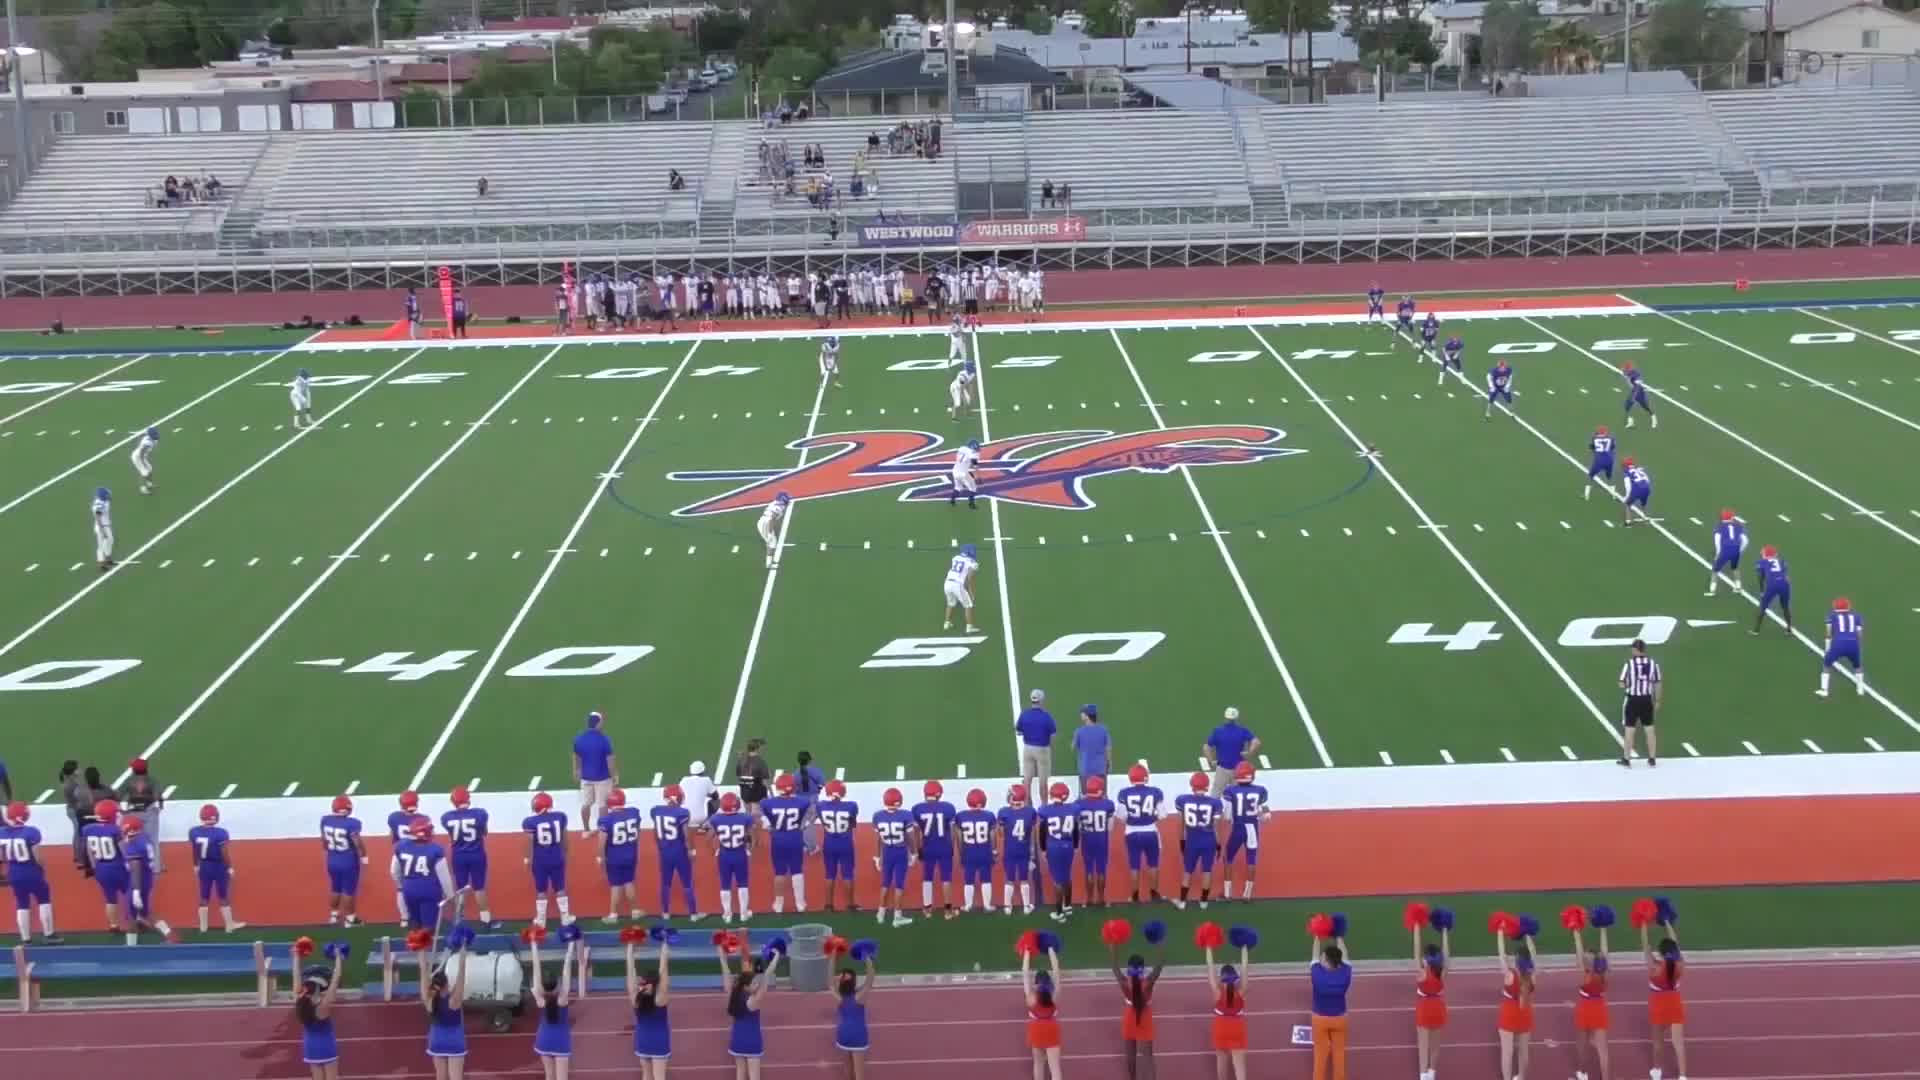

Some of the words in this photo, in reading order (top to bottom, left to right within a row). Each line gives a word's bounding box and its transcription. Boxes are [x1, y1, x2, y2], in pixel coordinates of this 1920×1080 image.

[864, 226, 954, 240] WESTWOOD
[977, 222, 1059, 237] WARRIORS
[1594, 437, 1612, 452] 57
[1727, 525, 1735, 540] 1
[1767, 559, 1781, 572] 3
[1837, 614, 1856, 632] 11
[1127, 795, 1152, 818] 54
[1185, 803, 1211, 826] 63
[1237, 793, 1259, 816] 13
[656, 816, 677, 839] 15
[772, 808, 799, 830] 72
[822, 811, 848, 832] 56
[921, 813, 943, 836] 71
[1012, 820, 1025, 840] 4
[1047, 816, 1073, 838] 24
[1081, 811, 1105, 832] 20
[324, 827, 348, 851] 55
[447, 819, 476, 842] 75
[537, 821, 561, 845] 61
[612, 820, 638, 844] 65
[717, 825, 745, 848] 22
[876, 822, 904, 844] 25
[962, 822, 988, 844] 28
[87, 836, 115, 860] 90
[196, 837, 208, 858] 7
[400, 853, 429, 877] 74
